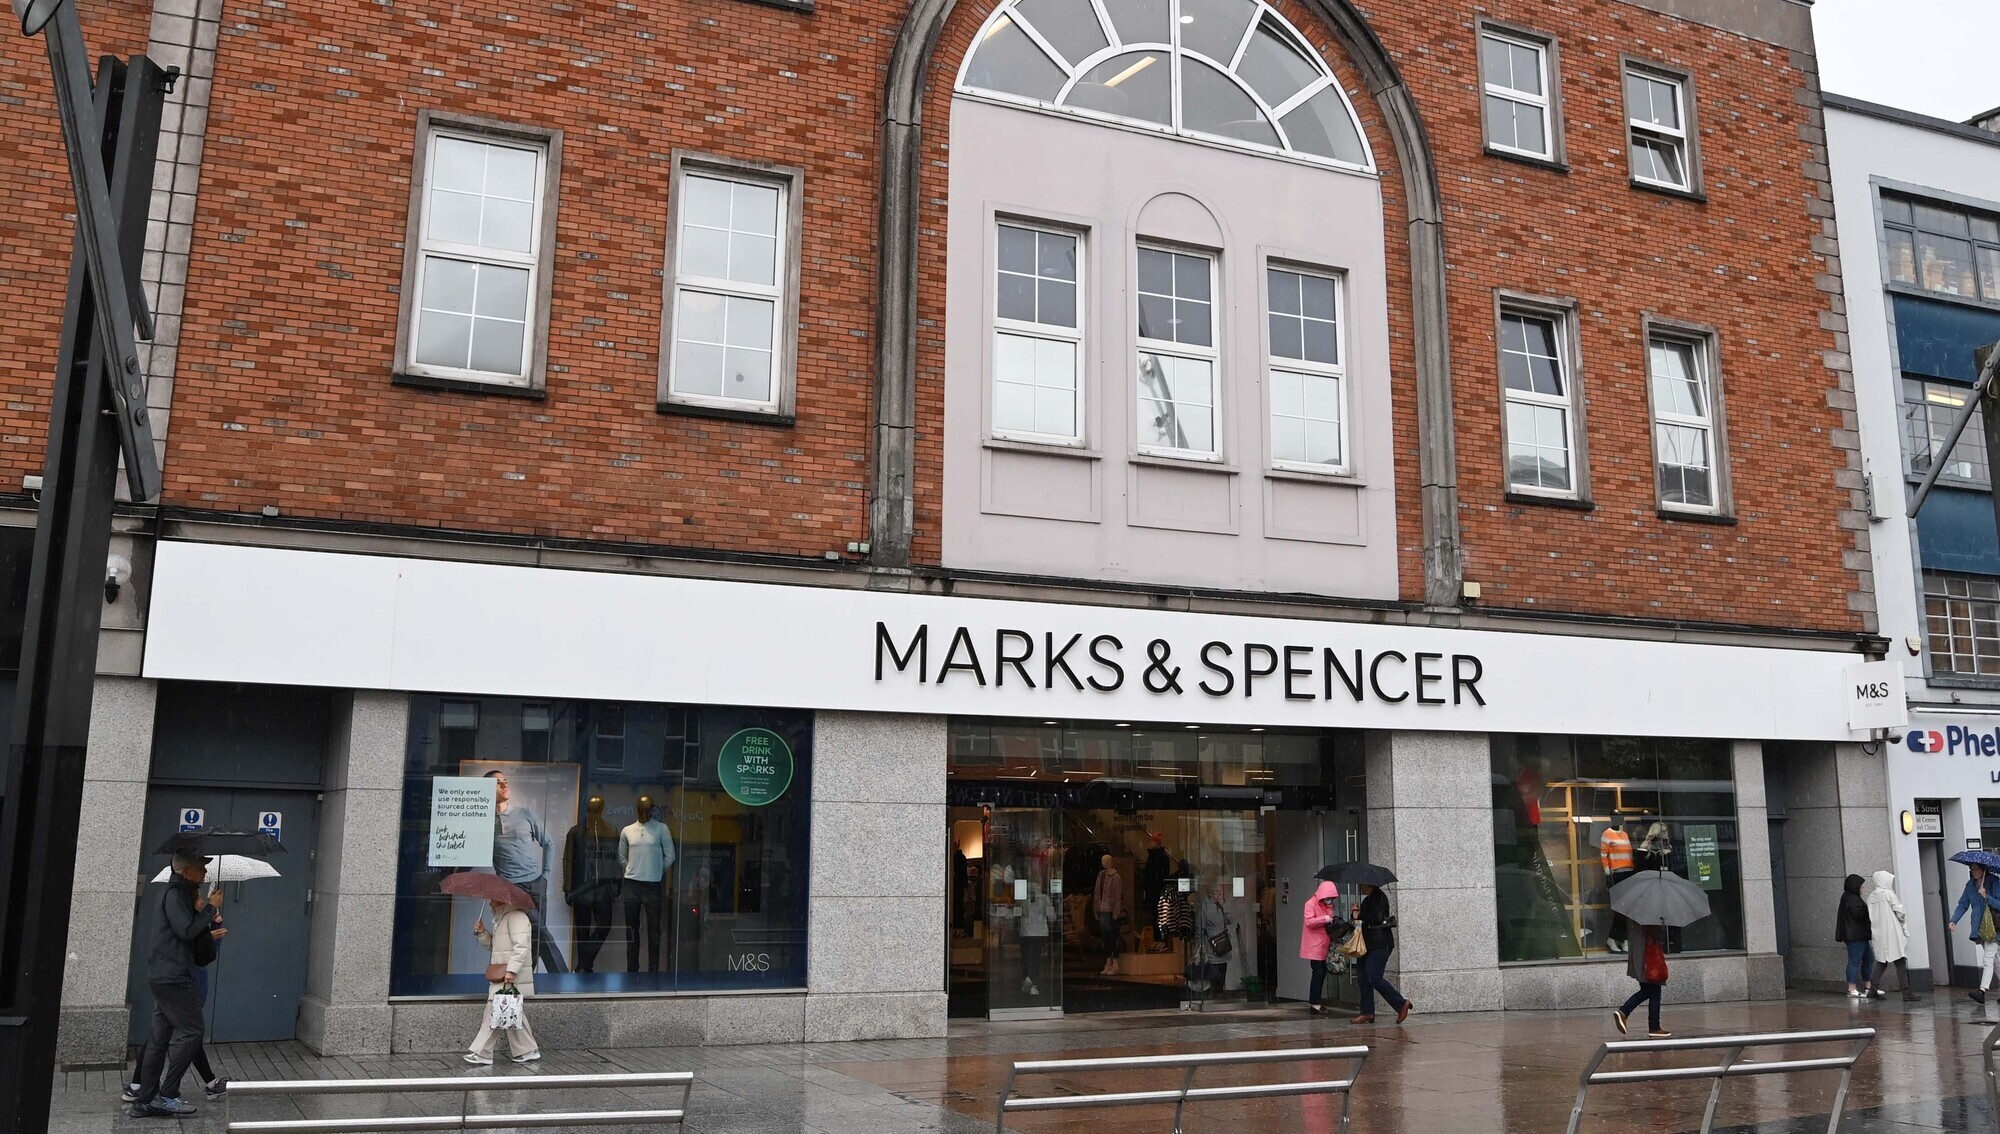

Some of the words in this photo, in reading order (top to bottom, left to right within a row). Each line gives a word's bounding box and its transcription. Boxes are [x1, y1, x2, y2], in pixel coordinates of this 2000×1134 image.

[874, 620, 1125, 691] MARKS
[1142, 637, 1184, 695] &
[1198, 640, 1487, 706] SPENCER
[1856, 681, 1889, 700] M&S
[745, 736, 769, 746] FREE
[741, 745, 772, 755] DRINK
[743, 755, 769, 765] WITH
[449, 788, 465, 796] only
[1921, 804, 1940, 812] Street
[438, 830, 466, 841] behind
[447, 840, 466, 850] label
[728, 953, 770, 971] M&S
